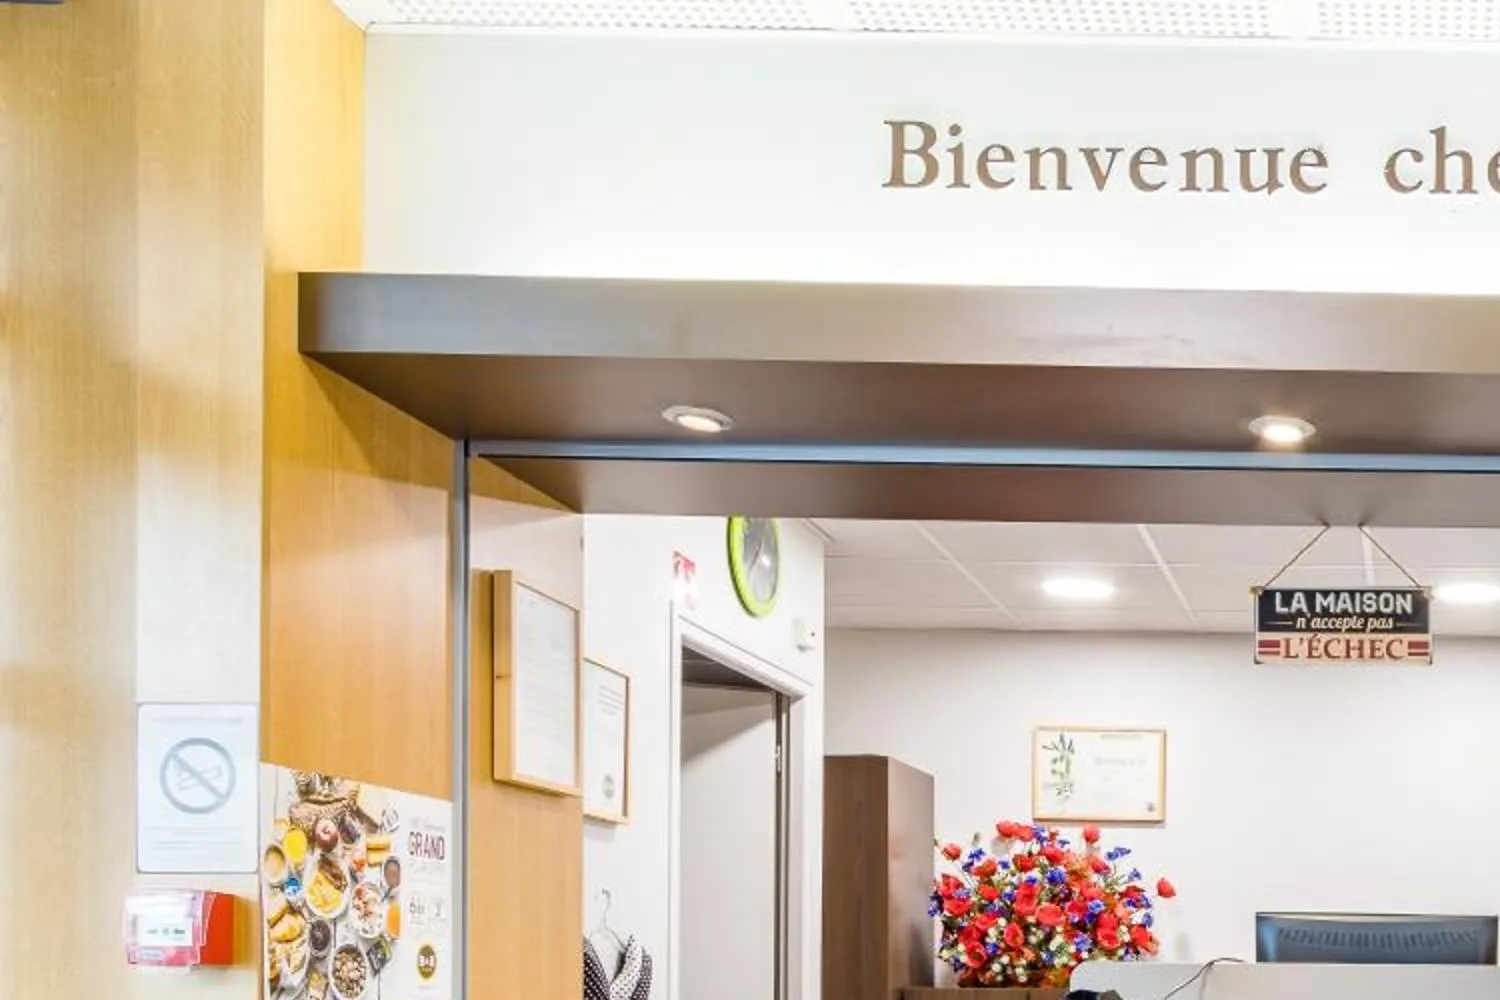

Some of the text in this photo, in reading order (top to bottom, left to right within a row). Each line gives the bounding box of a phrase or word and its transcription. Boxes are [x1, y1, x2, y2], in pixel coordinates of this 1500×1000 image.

[881, 119, 1328, 197] Bienvenue
[1275, 592, 1413, 614] LA MAISON
[1295, 613, 1394, 632] n'accepte pas
[1283, 633, 1403, 660] L'ÉCHEC
[409, 831, 446, 860] GRAND
